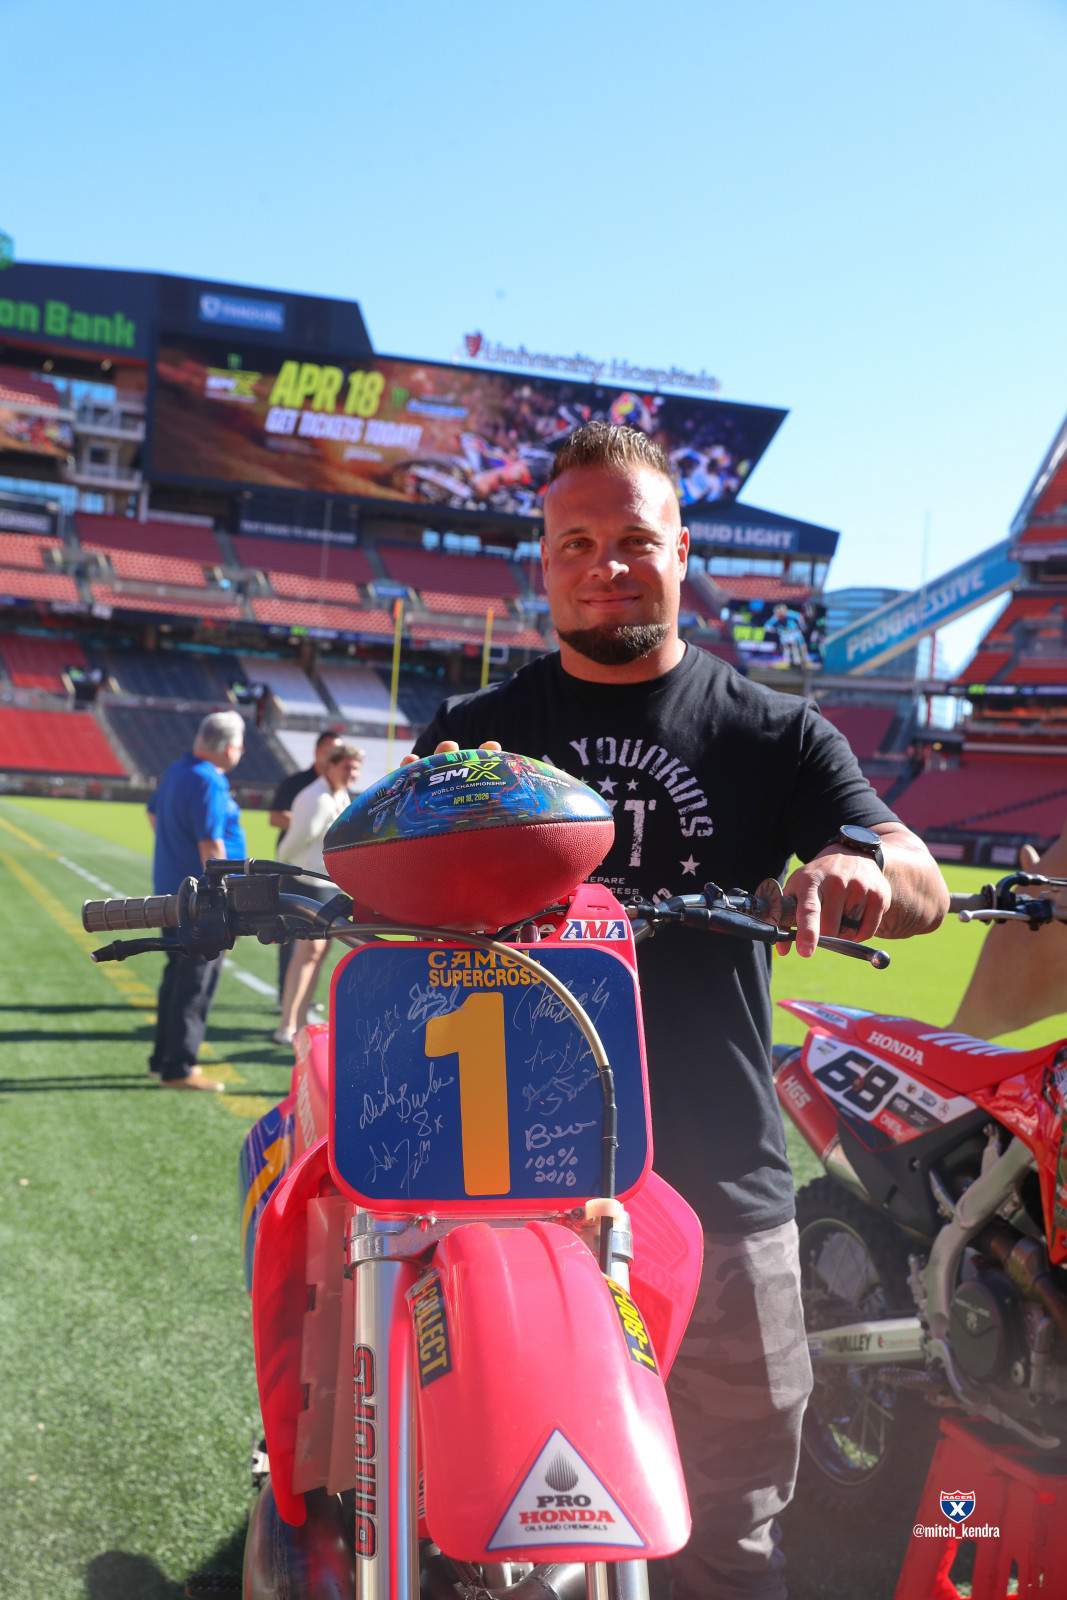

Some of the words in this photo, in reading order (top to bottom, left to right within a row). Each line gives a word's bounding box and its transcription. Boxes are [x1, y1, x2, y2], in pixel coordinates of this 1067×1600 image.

[44, 298, 136, 349] Bank
[484, 342, 605, 380] University
[611, 358, 721, 391] Hospitals
[269, 360, 344, 414] APR
[344, 370, 385, 418] 18
[688, 520, 731, 544] BUD
[733, 525, 795, 550] LIGHT
[846, 561, 987, 661] PROGRESSIVE
[428, 762, 502, 787] SMX
[431, 786, 455, 797] WORLD
[455, 780, 507, 791] CHAMPIONSHIP
[453, 796, 465, 806] APR
[474, 792, 490, 802] 2026
[563, 920, 627, 939] AMA
[428, 967, 542, 988] SUPERCROSS
[866, 1031, 925, 1067] HONDA
[424, 992, 511, 1196] 1
[781, 1075, 812, 1110] HGS
[812, 1050, 899, 1114] 68
[534, 1169, 577, 1187] 2018
[535, 1494, 593, 1509] PRO
[518, 1509, 616, 1526] HONDA
[524, 1524, 543, 1533] OILS
[544, 1523, 562, 1532] AND
[562, 1522, 609, 1532] CHEMICALS
